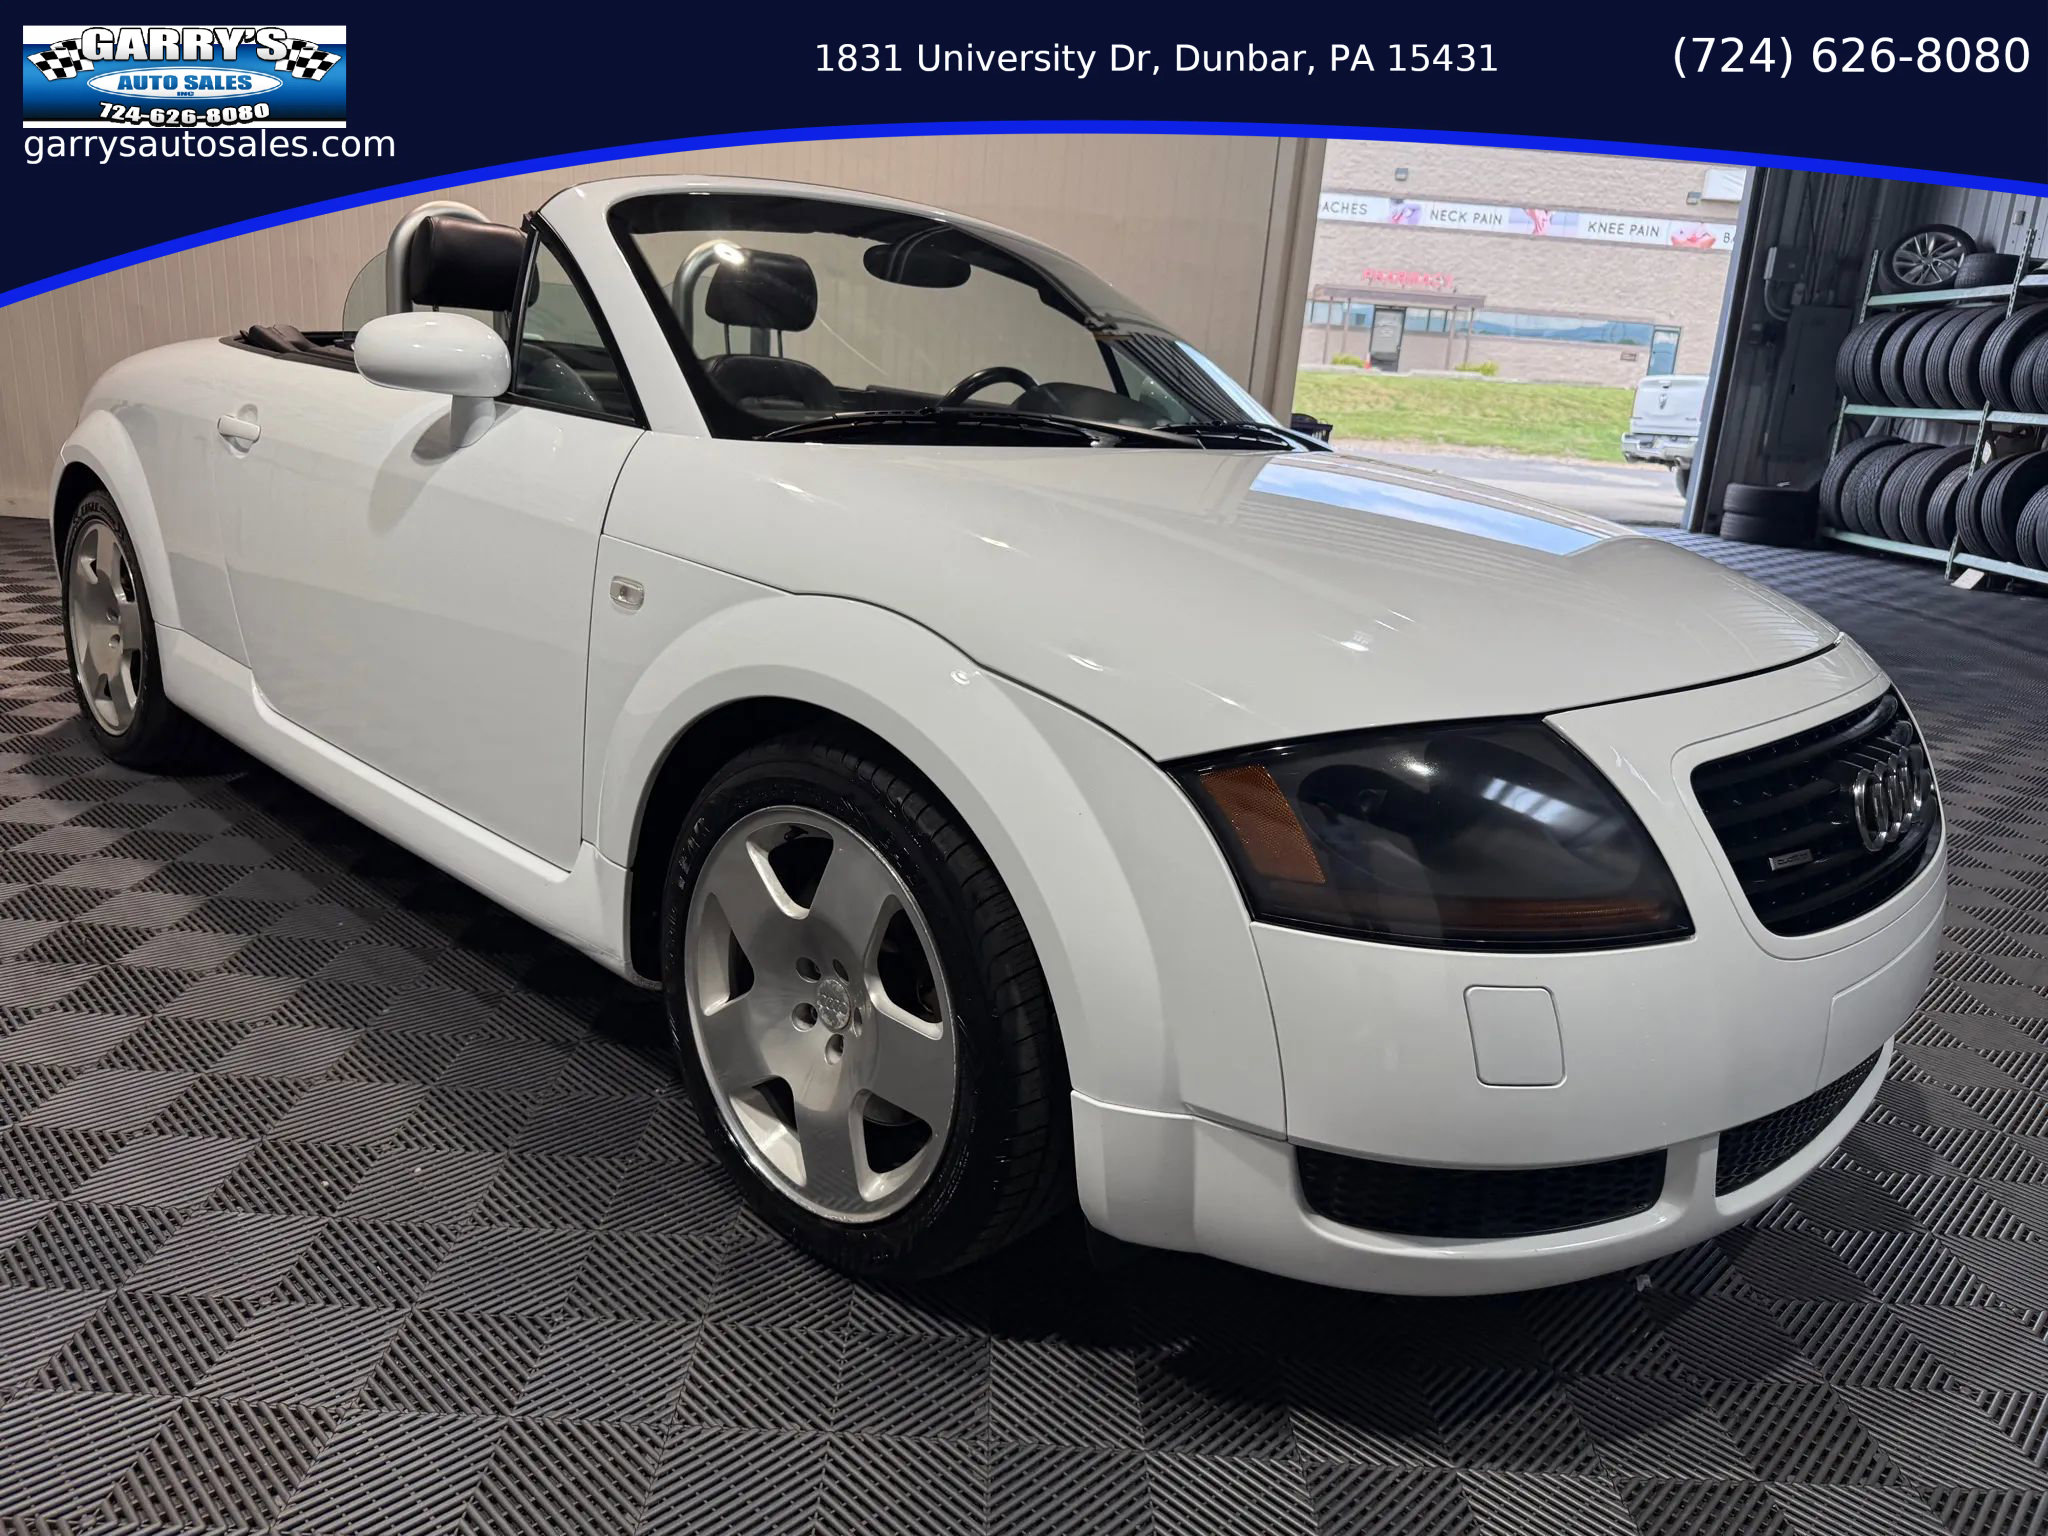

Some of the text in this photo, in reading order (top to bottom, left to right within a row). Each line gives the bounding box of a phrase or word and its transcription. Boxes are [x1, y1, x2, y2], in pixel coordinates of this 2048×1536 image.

[1322, 201, 1368, 215] ACHES
[1430, 209, 1468, 223] NECK
[1472, 212, 1503, 225] PAIN
[1588, 221, 1625, 235] KNEE
[1629, 224, 1660, 237] PAIN
